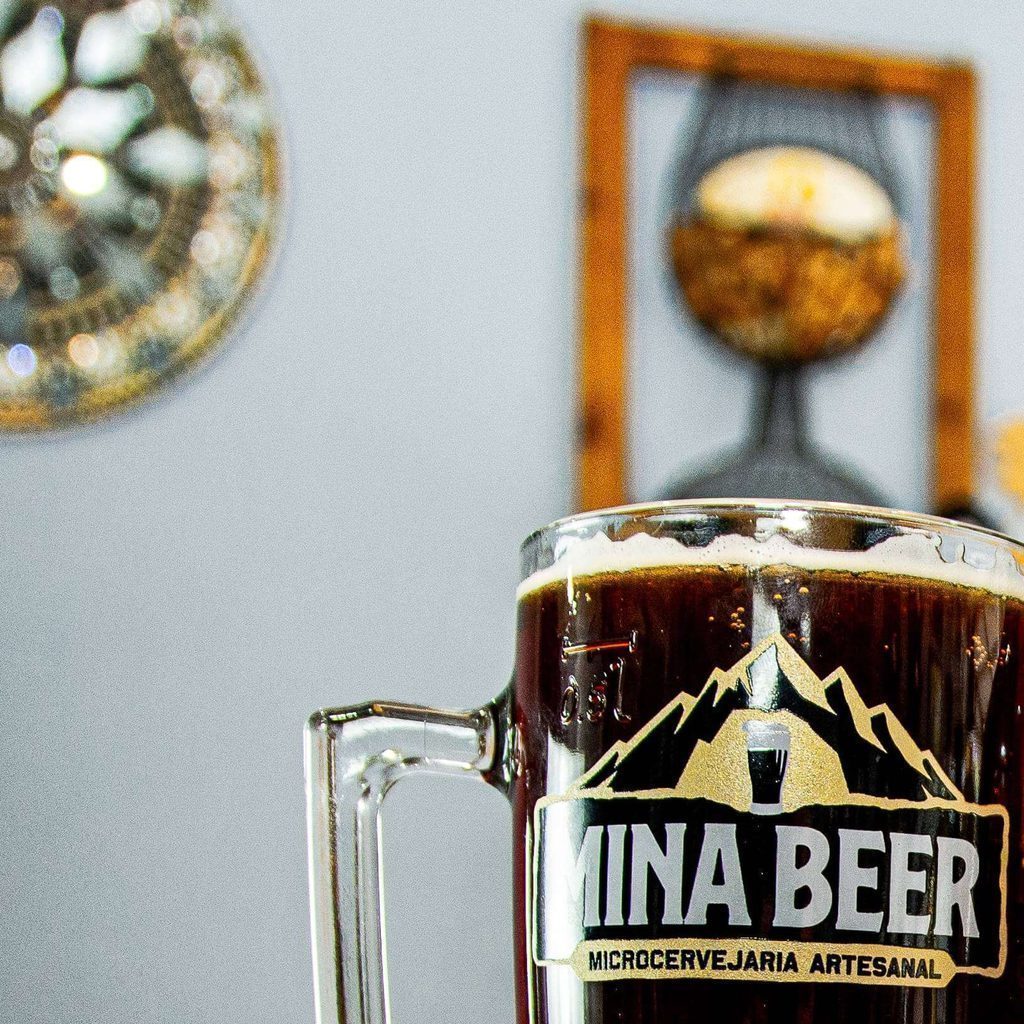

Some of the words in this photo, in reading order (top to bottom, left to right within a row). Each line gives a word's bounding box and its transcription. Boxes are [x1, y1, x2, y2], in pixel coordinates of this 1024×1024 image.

[772, 824, 981, 938] BEER
[588, 948, 799, 974] MICROCERVEJARIA
[809, 951, 943, 981] ARTESANAL
